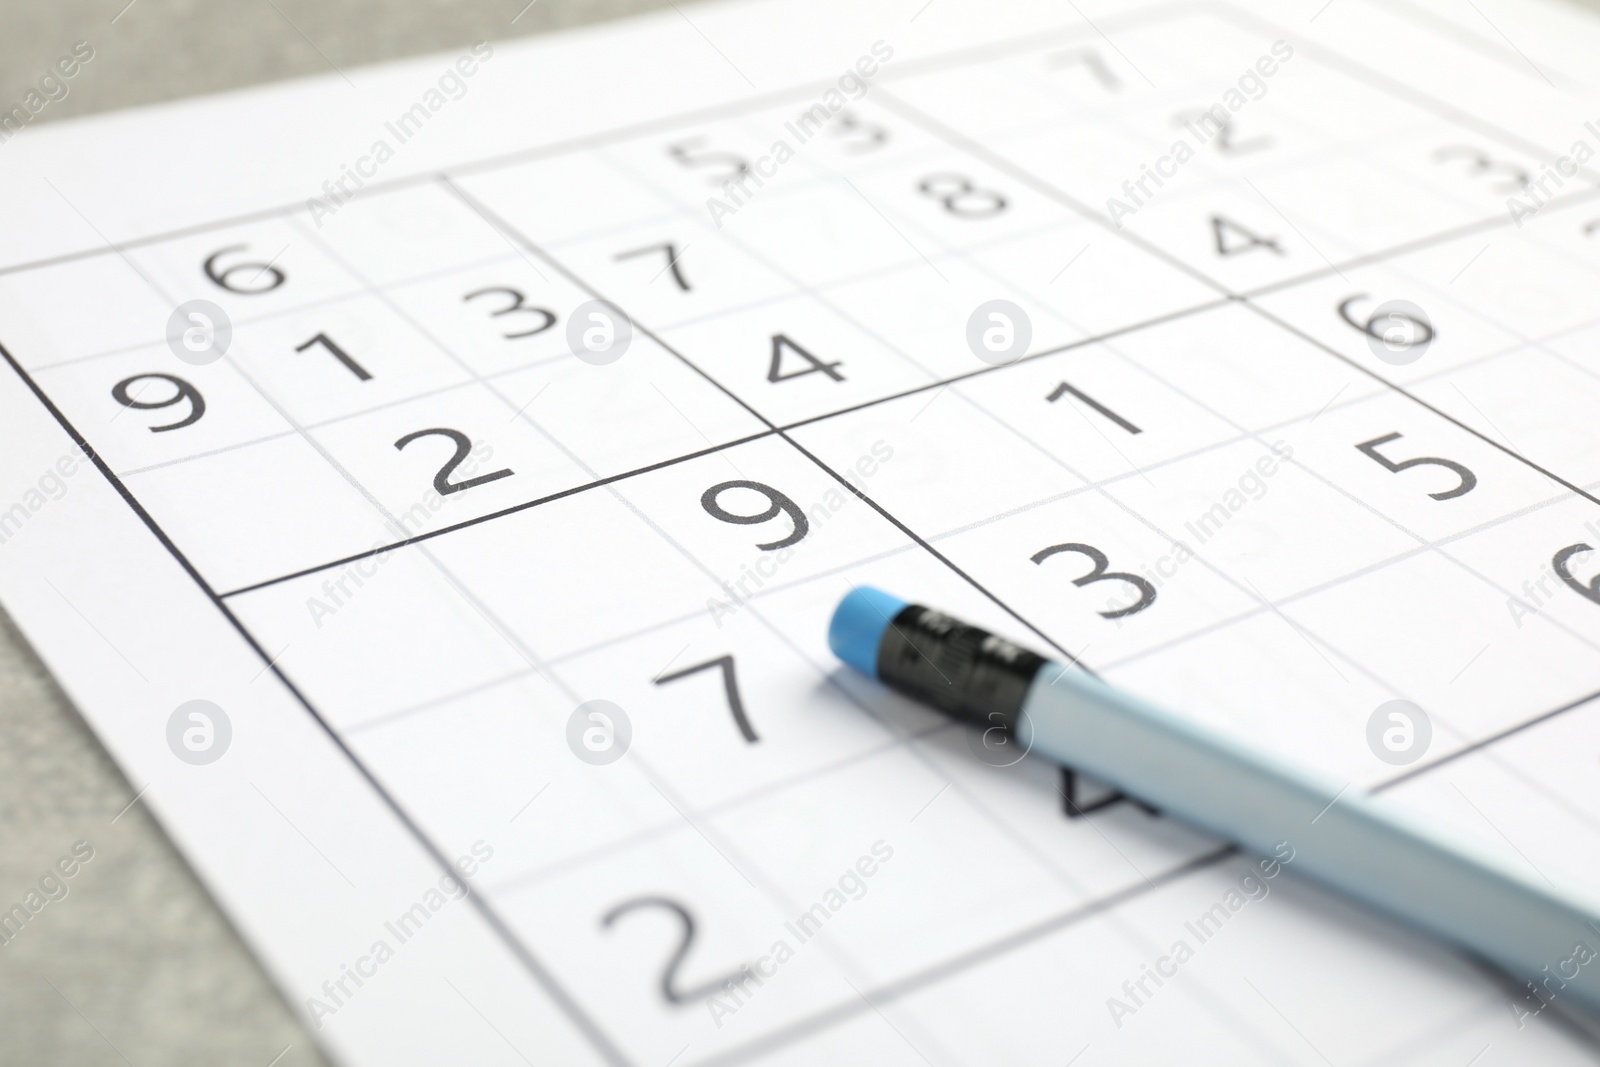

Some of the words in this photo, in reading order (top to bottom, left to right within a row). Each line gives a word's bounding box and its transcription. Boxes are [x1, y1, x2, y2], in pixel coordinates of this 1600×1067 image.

[916, 171, 1011, 221] 8
[1208, 213, 1286, 259] 4
[202, 245, 287, 296] 6
[614, 242, 694, 294] 7
[462, 285, 559, 340] 3
[1336, 293, 1438, 350] 6
[294, 331, 374, 383] 1
[766, 333, 846, 385] 4
[110, 372, 207, 434] 9
[1045, 380, 1143, 436] 1
[393, 427, 516, 497] 2
[1355, 431, 1478, 502] 5
[700, 479, 810, 552] 9
[1030, 542, 1158, 620] 3
[652, 654, 762, 746] 7
[601, 894, 758, 1006] 2
